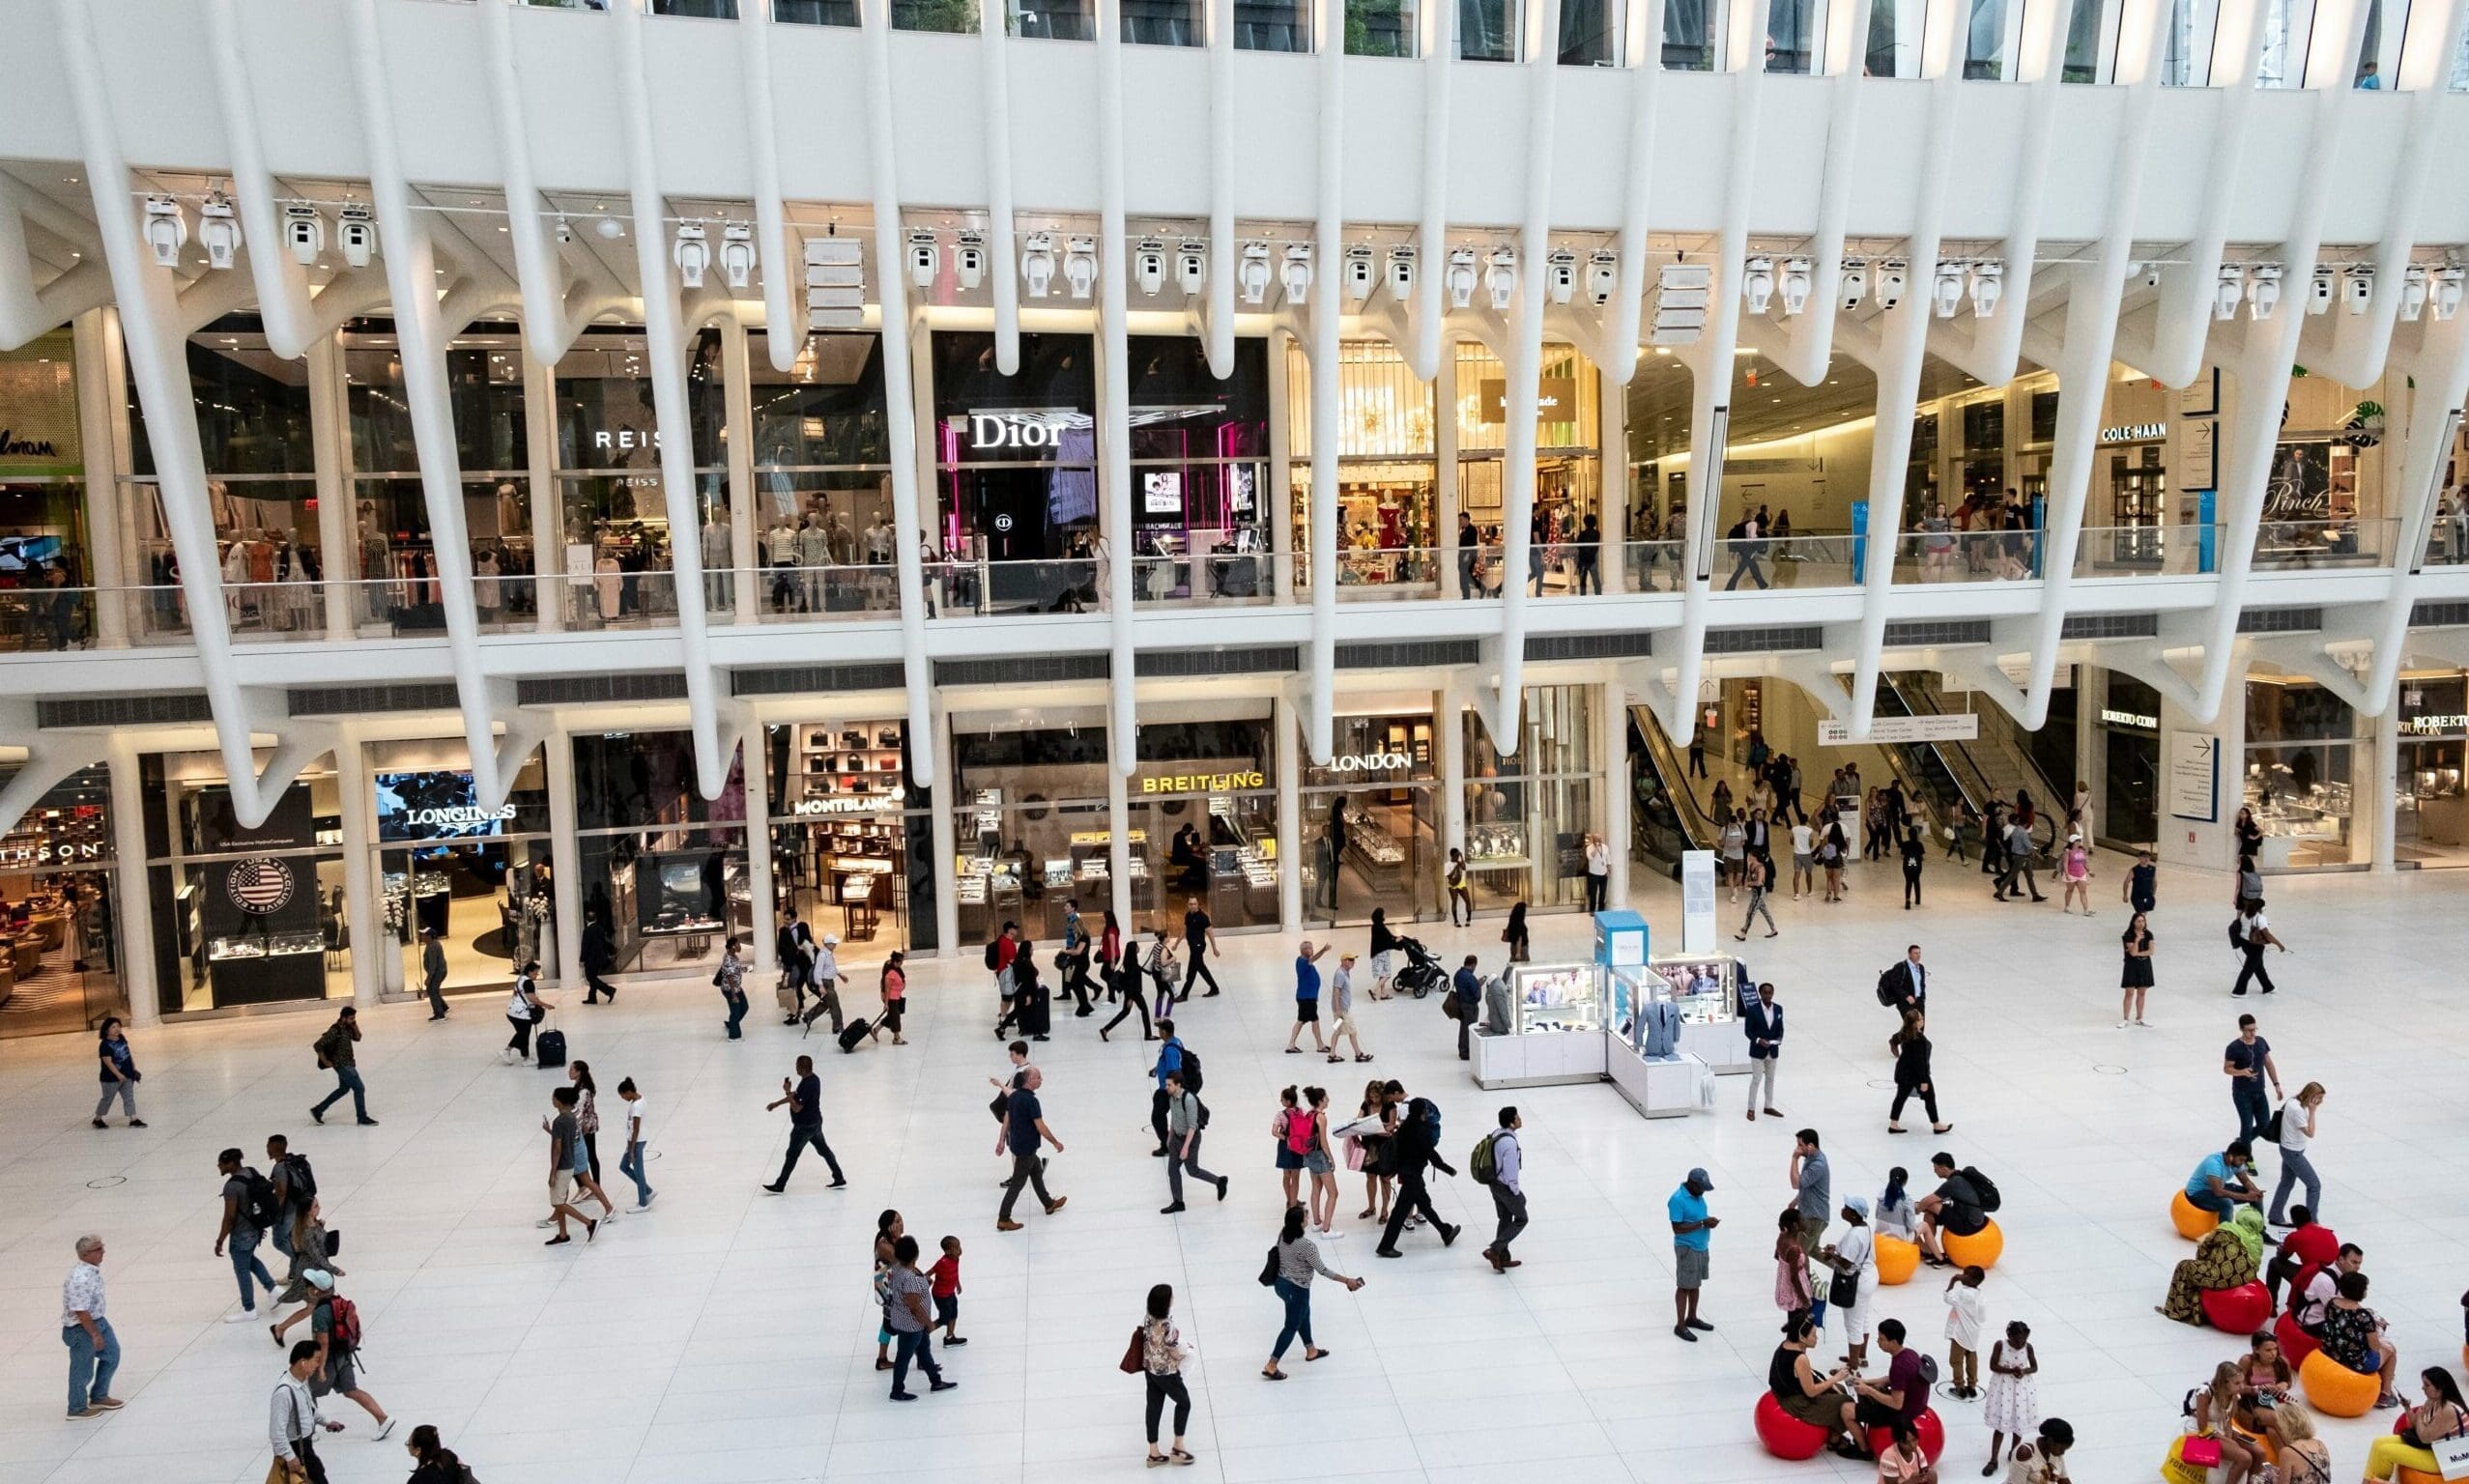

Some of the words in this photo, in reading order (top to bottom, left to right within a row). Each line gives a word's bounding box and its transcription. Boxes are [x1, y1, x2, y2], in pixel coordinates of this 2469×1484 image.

[595, 431, 661, 448] REIS
[970, 414, 1066, 447] Dior
[2102, 427, 2131, 442] COLE
[2135, 422, 2167, 439] HAAN
[616, 477, 658, 487] REISS
[2263, 479, 2330, 519] Pinch
[2102, 709, 2136, 725] ROBERTO
[2136, 714, 2158, 728] COIN
[1331, 753, 1412, 772] LONDON
[1143, 773, 1264, 792] BREITLING
[794, 796, 893, 814] MONTBLANC
[0, 843, 98, 861] THSON
[230, 870, 249, 908] EDITION
[258, 867, 292, 912] EXCLUSIVE
